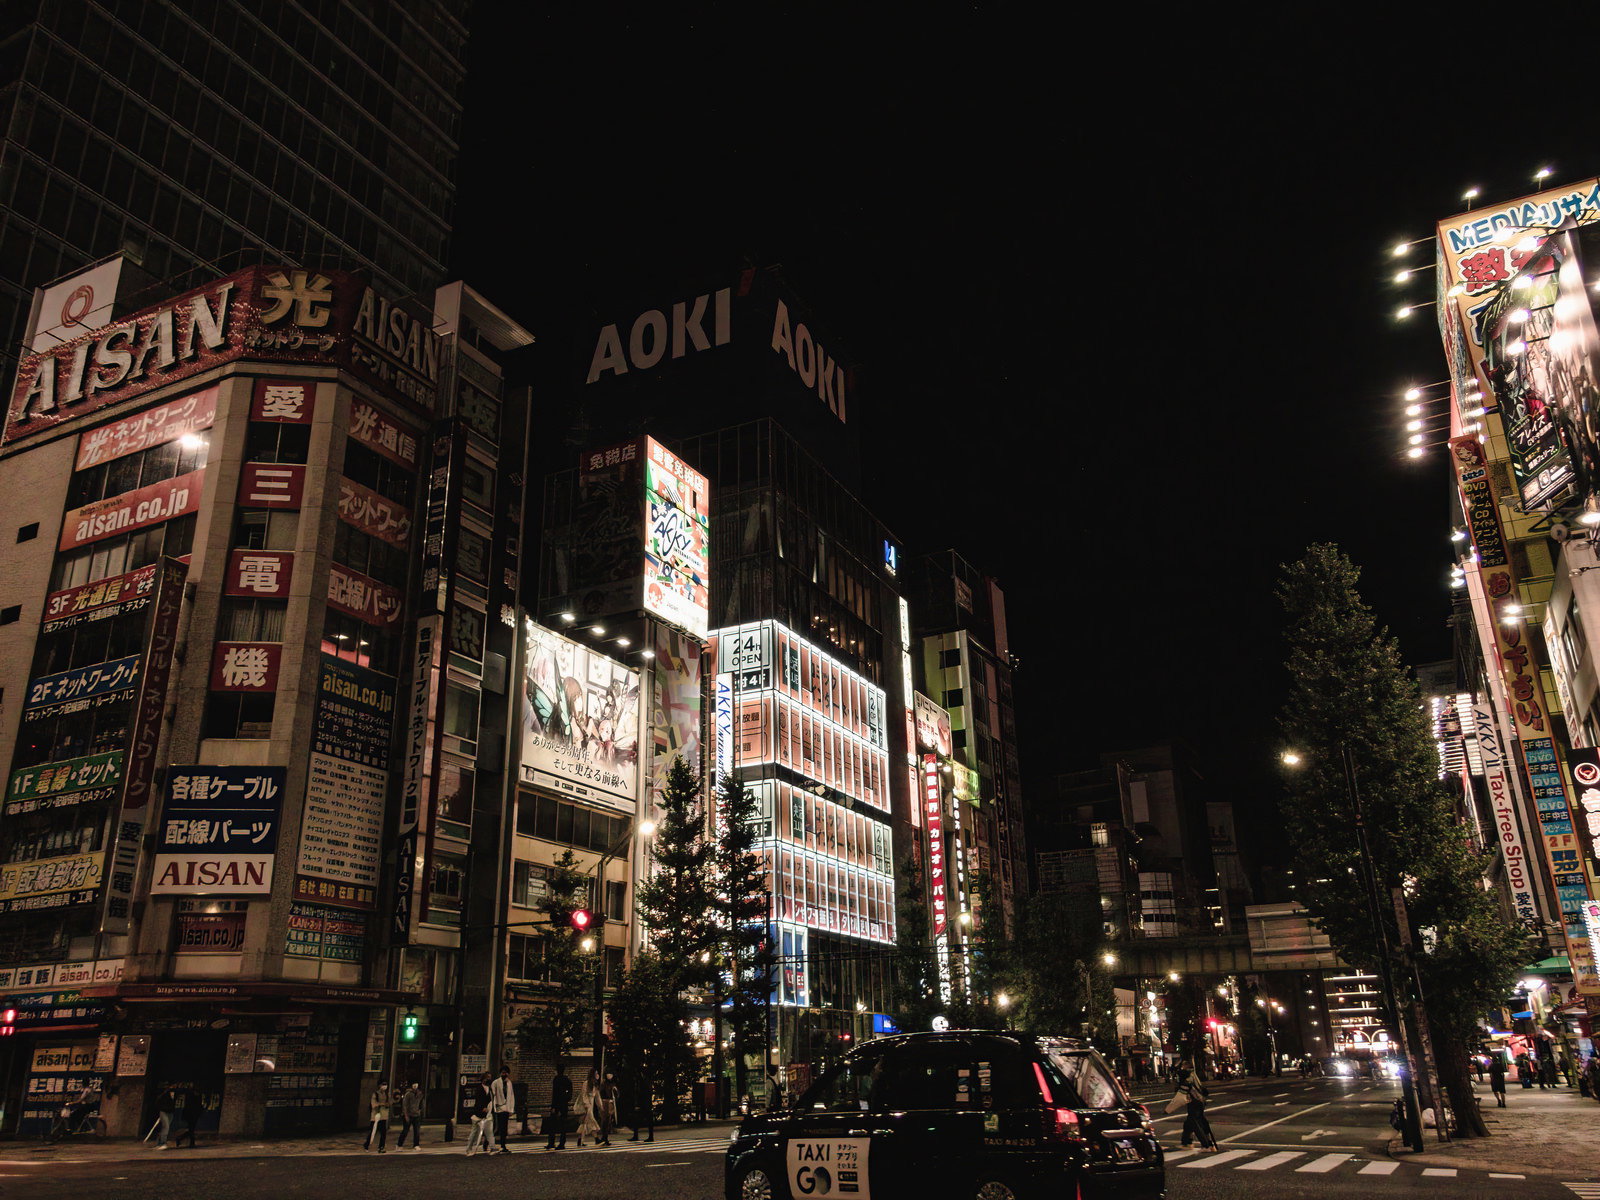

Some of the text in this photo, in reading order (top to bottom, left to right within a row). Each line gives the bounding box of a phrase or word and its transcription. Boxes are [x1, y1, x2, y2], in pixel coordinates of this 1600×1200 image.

[260, 270, 333, 328] 光
[15, 281, 235, 421] AISAN
[353, 286, 439, 385] AISAN
[586, 287, 731, 384] AOKI
[771, 298, 846, 424] AOKI
[262, 385, 304, 419] 愛
[250, 469, 293, 502] 三
[1464, 482, 1487, 494] DVD
[75, 488, 190, 542] aisan.co.jp
[338, 485, 412, 542] ネットワーク
[1475, 510, 1490, 519] CD
[1475, 528, 1499, 540] アニメ
[239, 556, 281, 593] 電
[50, 594, 72, 616] 3F
[328, 568, 402, 623] 配線パーツ
[222, 647, 269, 687] 機
[31, 682, 55, 704] 2F
[323, 672, 393, 713] aisan.co.jp
[717, 680, 732, 735] AKKY
[171, 774, 280, 802] 各種ケーブル
[555, 760, 629, 791] そして更なる前線へ
[1475, 709, 1499, 758] AKKY
[1490, 771, 1513, 842] Tax-free
[1503, 843, 1526, 890] Shop
[165, 818, 273, 845] 配線パーツ
[158, 860, 267, 887] AISAN
[395, 839, 413, 934] AISAN
[177, 924, 245, 951] isan.co.jp
[36, 1050, 97, 1070] aisan.co.j
[797, 1143, 831, 1162] TAXI
[796, 1165, 832, 1196] GO
